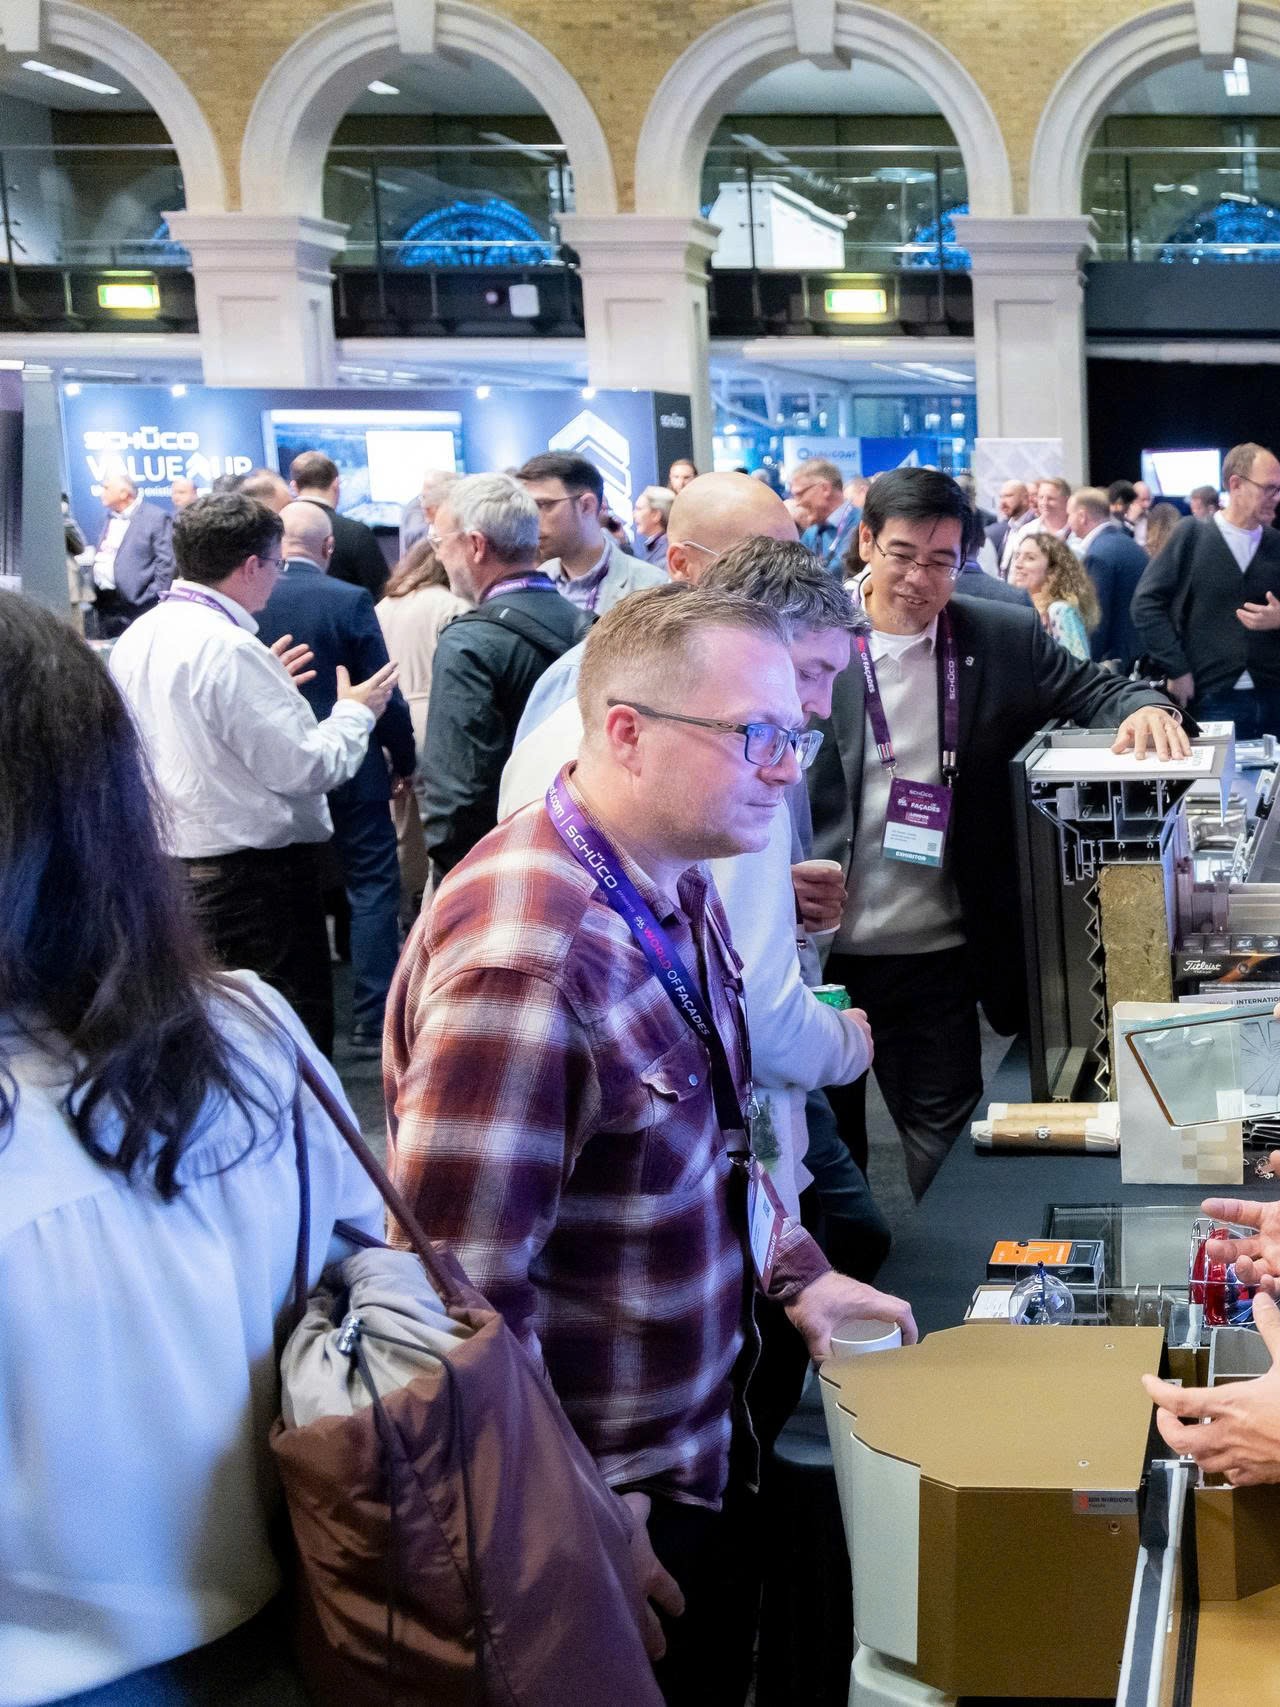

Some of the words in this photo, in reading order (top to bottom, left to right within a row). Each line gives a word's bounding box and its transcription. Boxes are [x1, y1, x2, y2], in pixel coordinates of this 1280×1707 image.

[565, 825, 618, 889] SCHÜCO
[643, 927, 673, 970] WORLD
[667, 970, 683, 988] OF
[675, 983, 711, 1036] FAÇADES
[1183, 960, 1221, 971] Titleist
